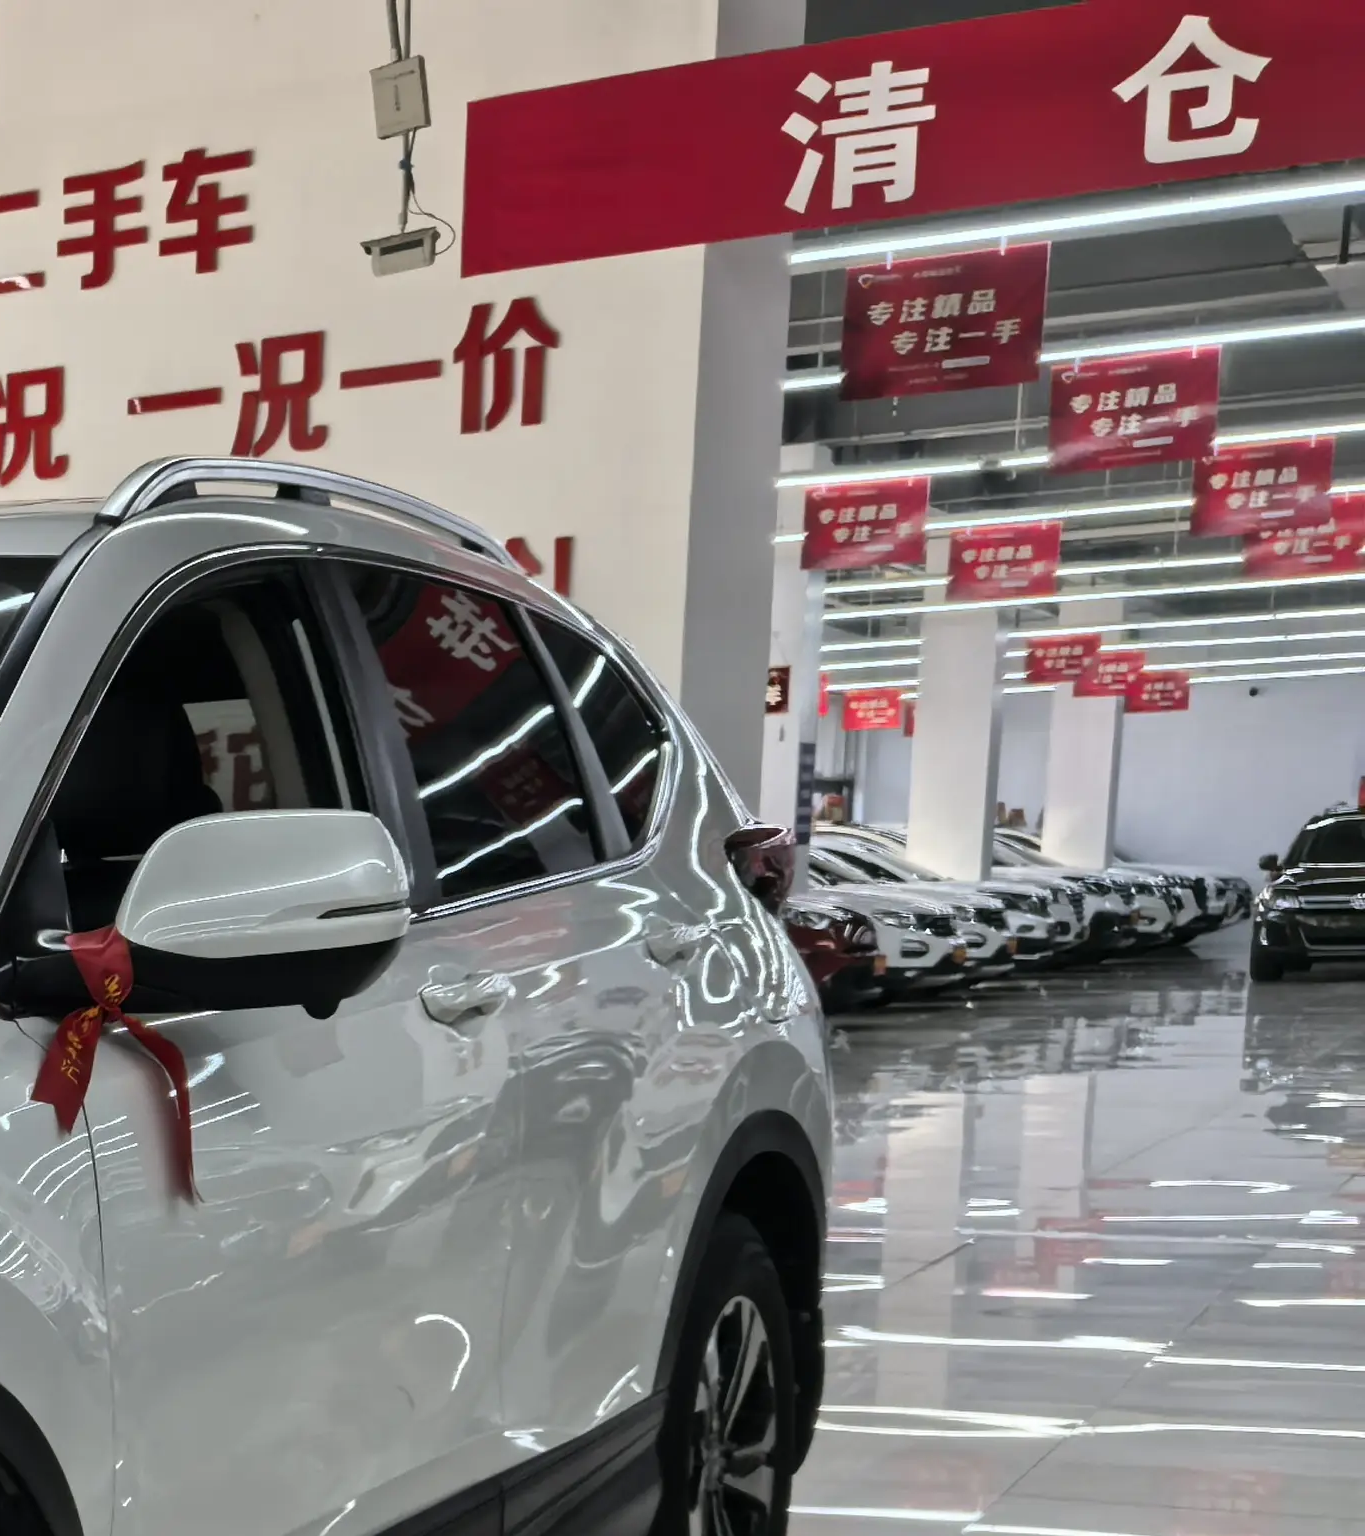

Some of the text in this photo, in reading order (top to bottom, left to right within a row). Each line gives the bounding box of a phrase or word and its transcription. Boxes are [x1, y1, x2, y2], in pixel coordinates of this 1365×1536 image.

[780, 14, 1273, 214] 清仓
[867, 288, 996, 326] 专注精品
[890, 318, 1022, 355] 专注一手
[127, 297, 561, 458] 一况一价
